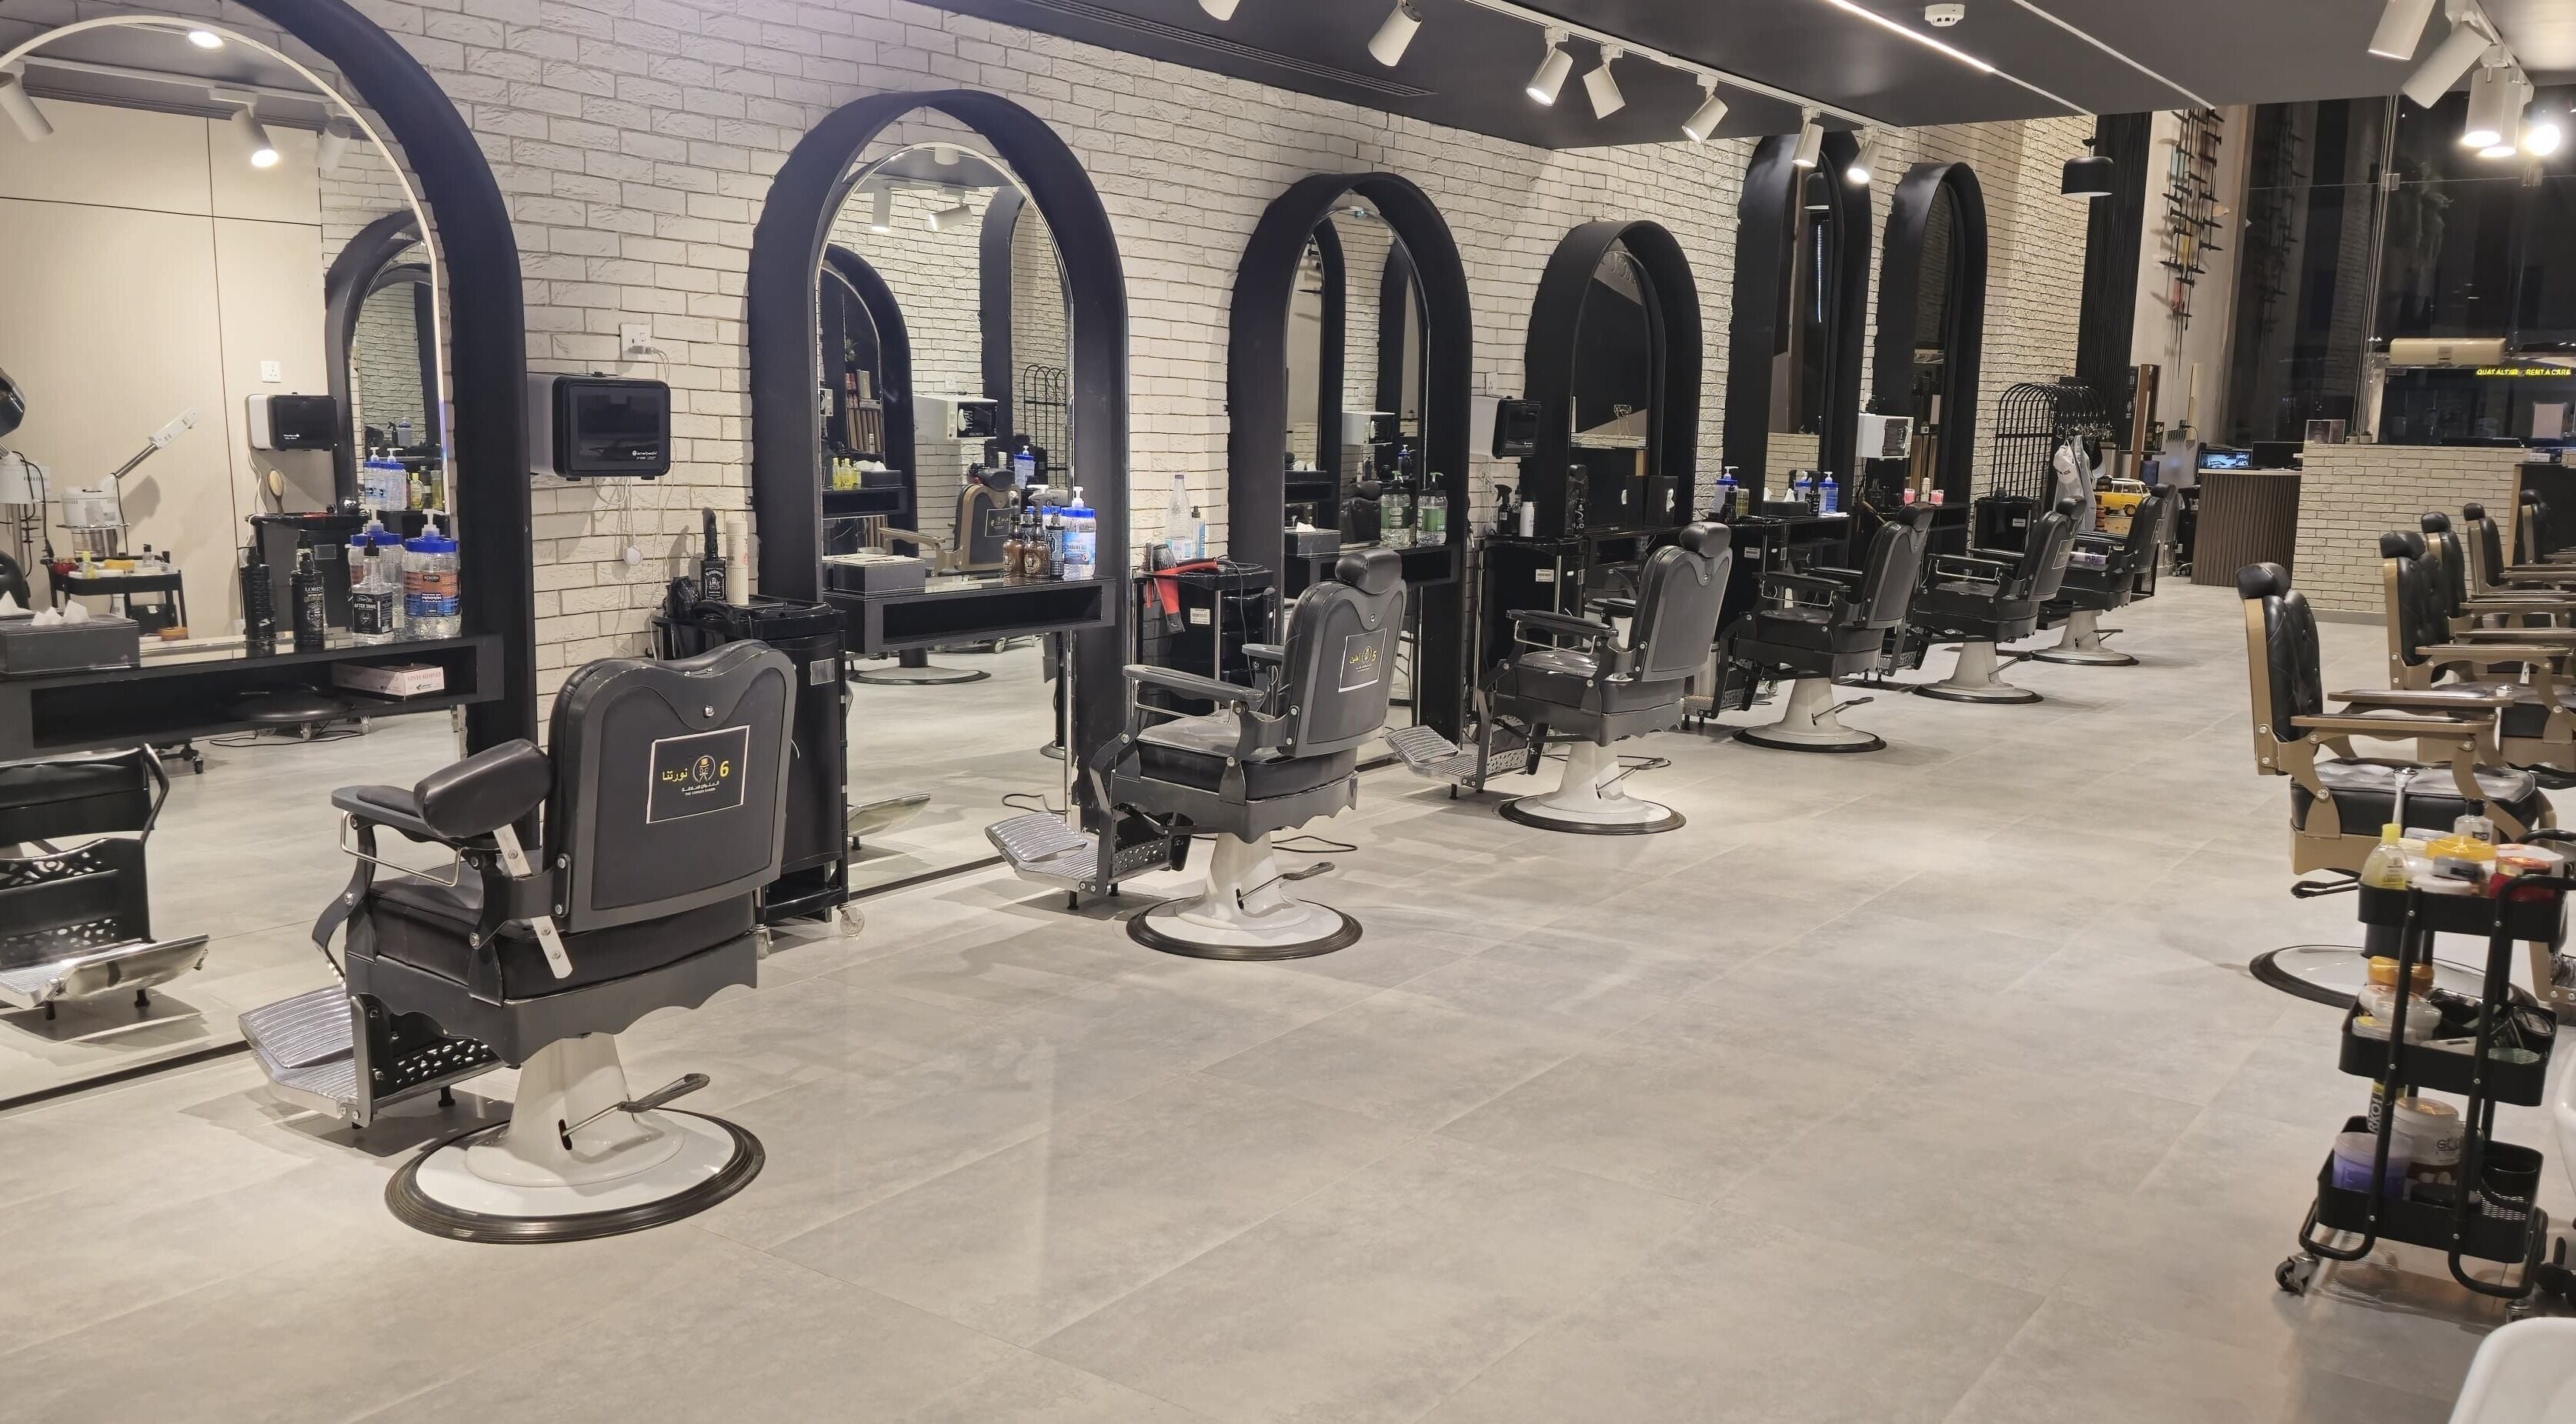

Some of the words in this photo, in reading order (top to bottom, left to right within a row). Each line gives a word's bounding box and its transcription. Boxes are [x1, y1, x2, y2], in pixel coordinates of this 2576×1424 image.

[1372, 650, 1377, 662] 5
[662, 767, 689, 782] نورتنا
[719, 760, 729, 777] 6
